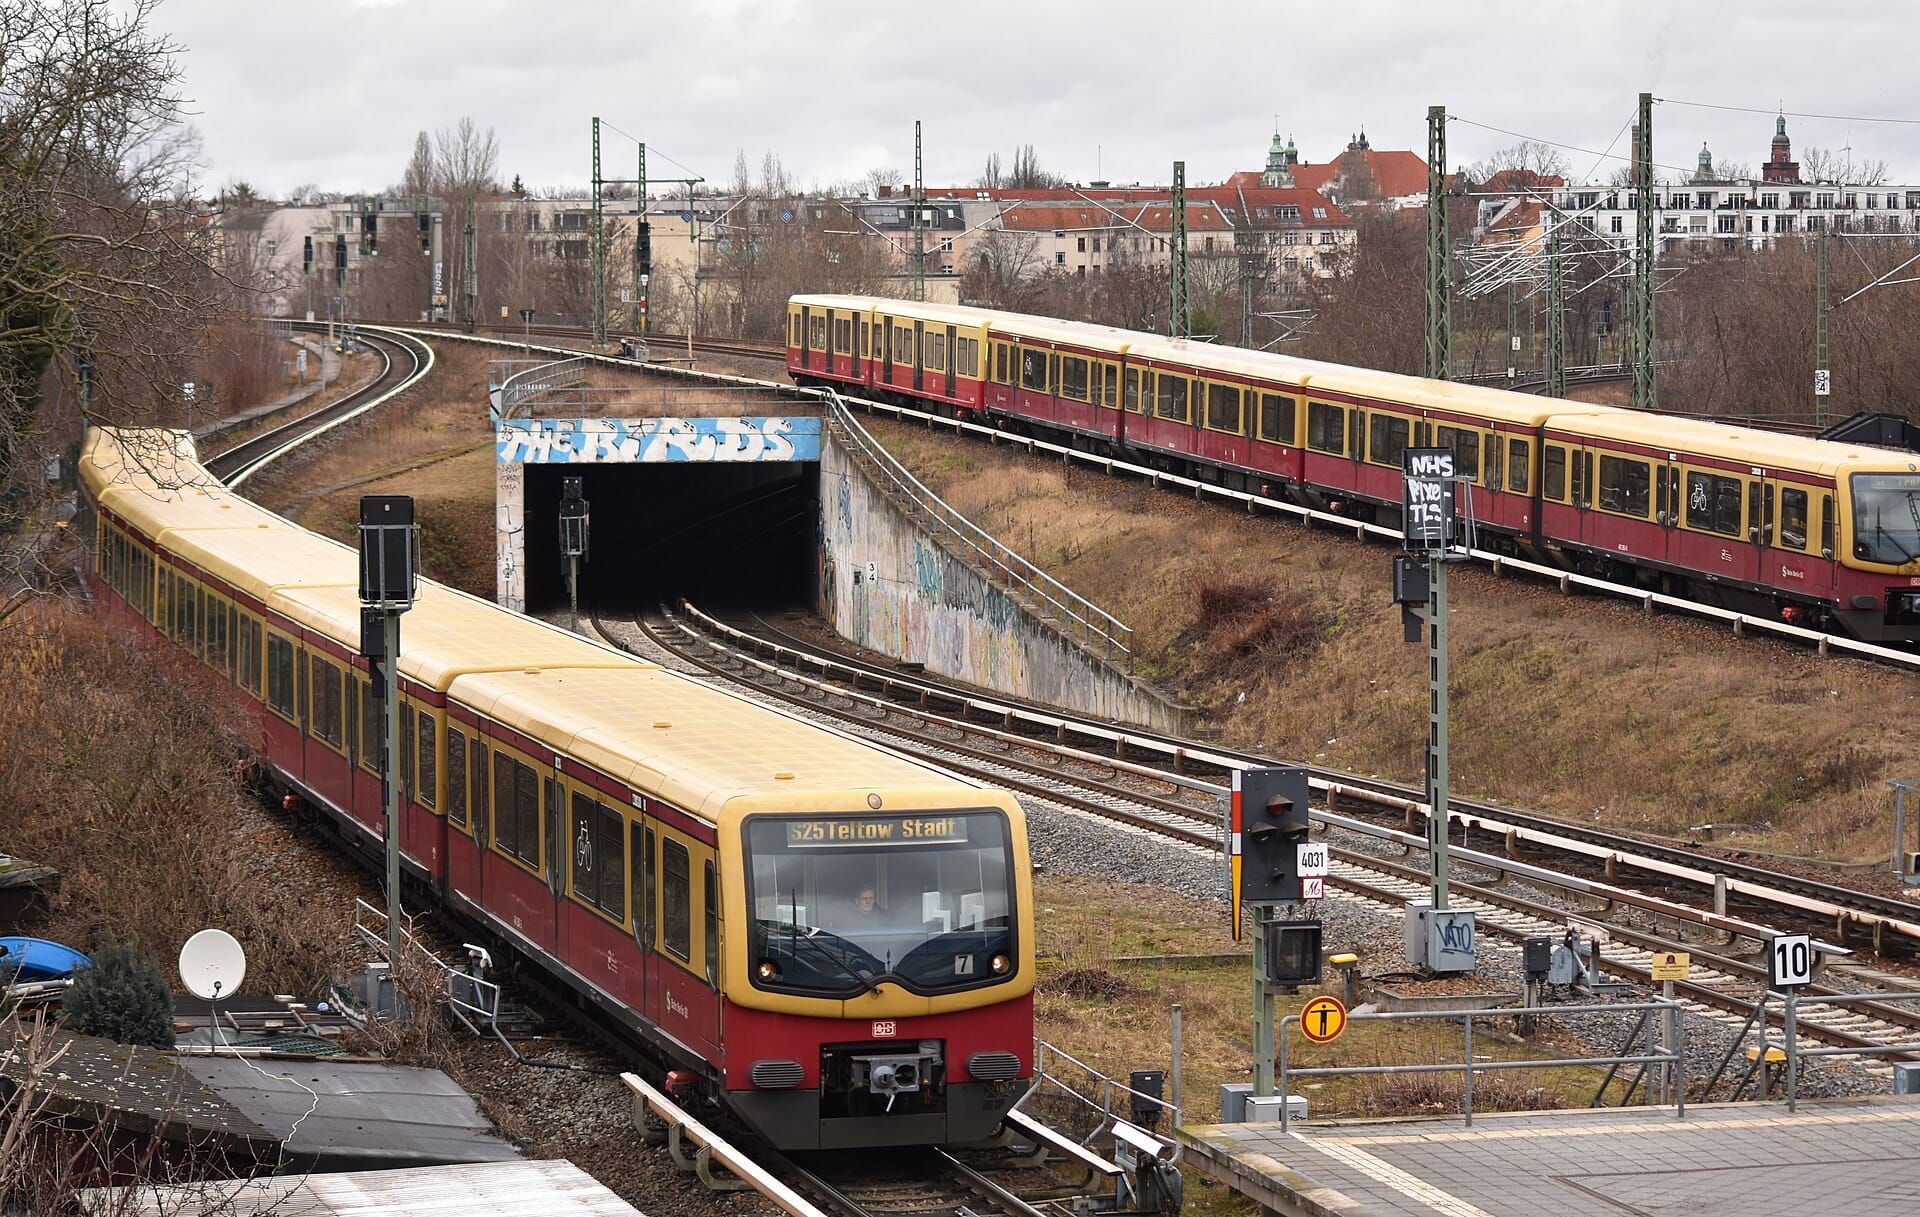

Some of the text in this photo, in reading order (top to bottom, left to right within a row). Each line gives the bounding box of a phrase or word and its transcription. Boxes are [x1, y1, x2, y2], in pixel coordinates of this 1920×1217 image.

[1411, 455, 1453, 477] NHS
[869, 563, 875, 571] 3
[869, 573, 875, 581] 4
[792, 817, 956, 840] S25 Teltow Stadt
[1301, 851, 1324, 868] 4031
[958, 955, 969, 973] 7
[1776, 942, 1808, 979] 10
[874, 1021, 894, 1036] DB
